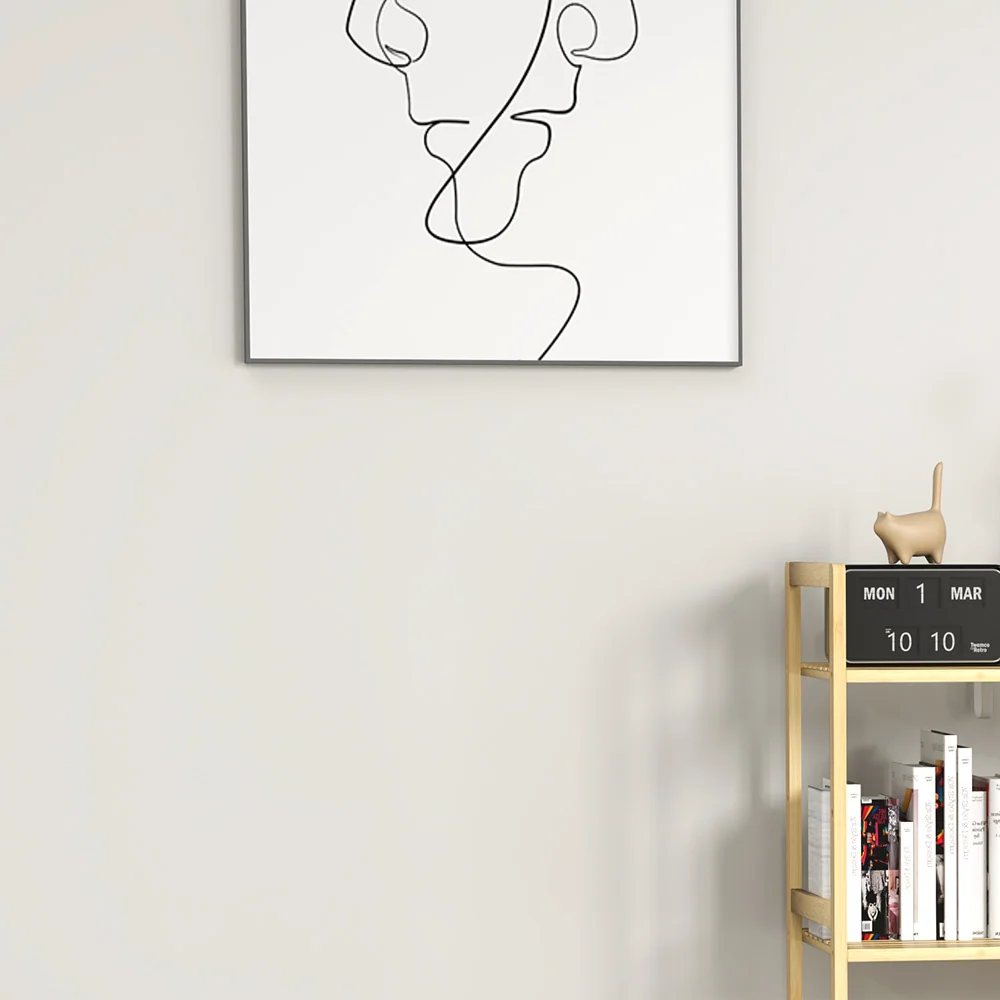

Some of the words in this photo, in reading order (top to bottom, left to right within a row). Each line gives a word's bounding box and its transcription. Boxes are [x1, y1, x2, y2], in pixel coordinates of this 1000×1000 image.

[863, 587, 895, 600] MON
[916, 583, 925, 604] 1
[951, 586, 982, 600] MAR
[887, 632, 912, 652] 10
[930, 632, 956, 652] 10
